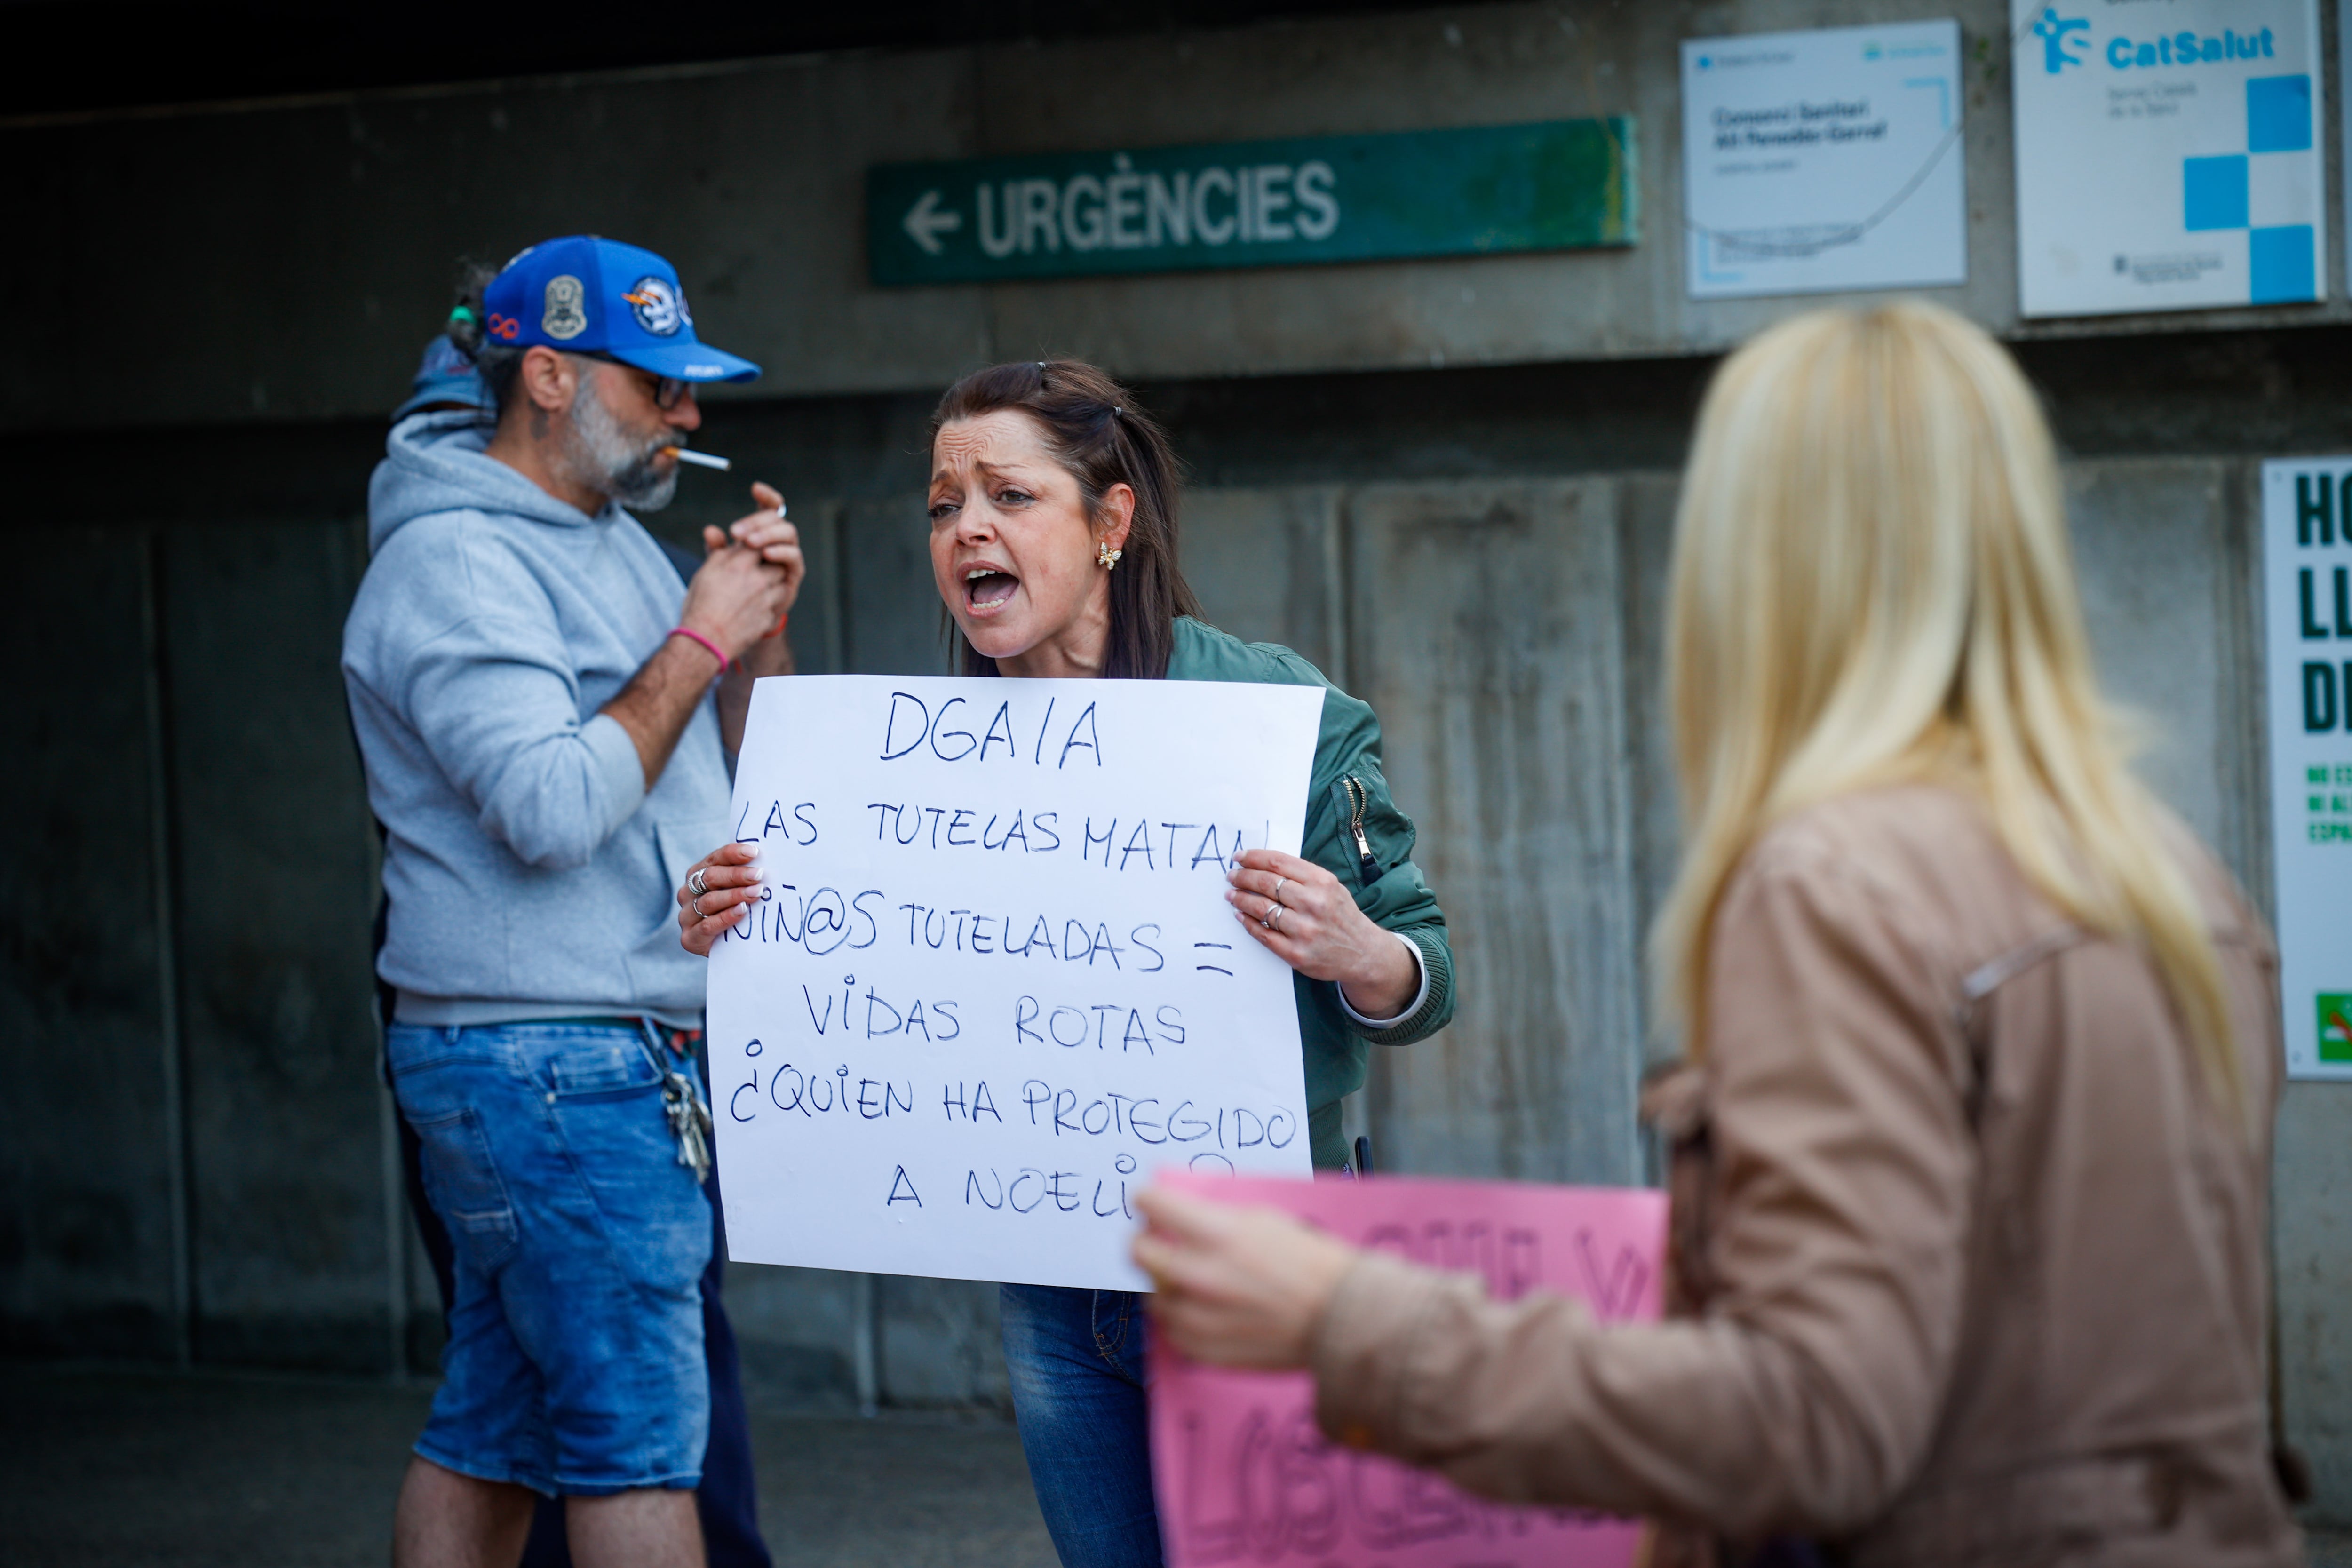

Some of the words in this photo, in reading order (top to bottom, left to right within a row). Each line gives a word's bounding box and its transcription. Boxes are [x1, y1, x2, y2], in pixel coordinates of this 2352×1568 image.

[2107, 27, 2273, 69] CatSalut
[977, 155, 1340, 257] URGÈNCIES
[879, 692, 1102, 770] DGAIA
[736, 799, 818, 846] LAS
[867, 803, 1061, 854] TUTELAS
[899, 902, 1164, 972] TUTELADAS
[1015, 995, 1185, 1056] ROTAS
[942, 1080, 1003, 1123] HA
[1022, 1080, 1296, 1150] PROTEGIDO
[886, 1164, 922, 1209] A
